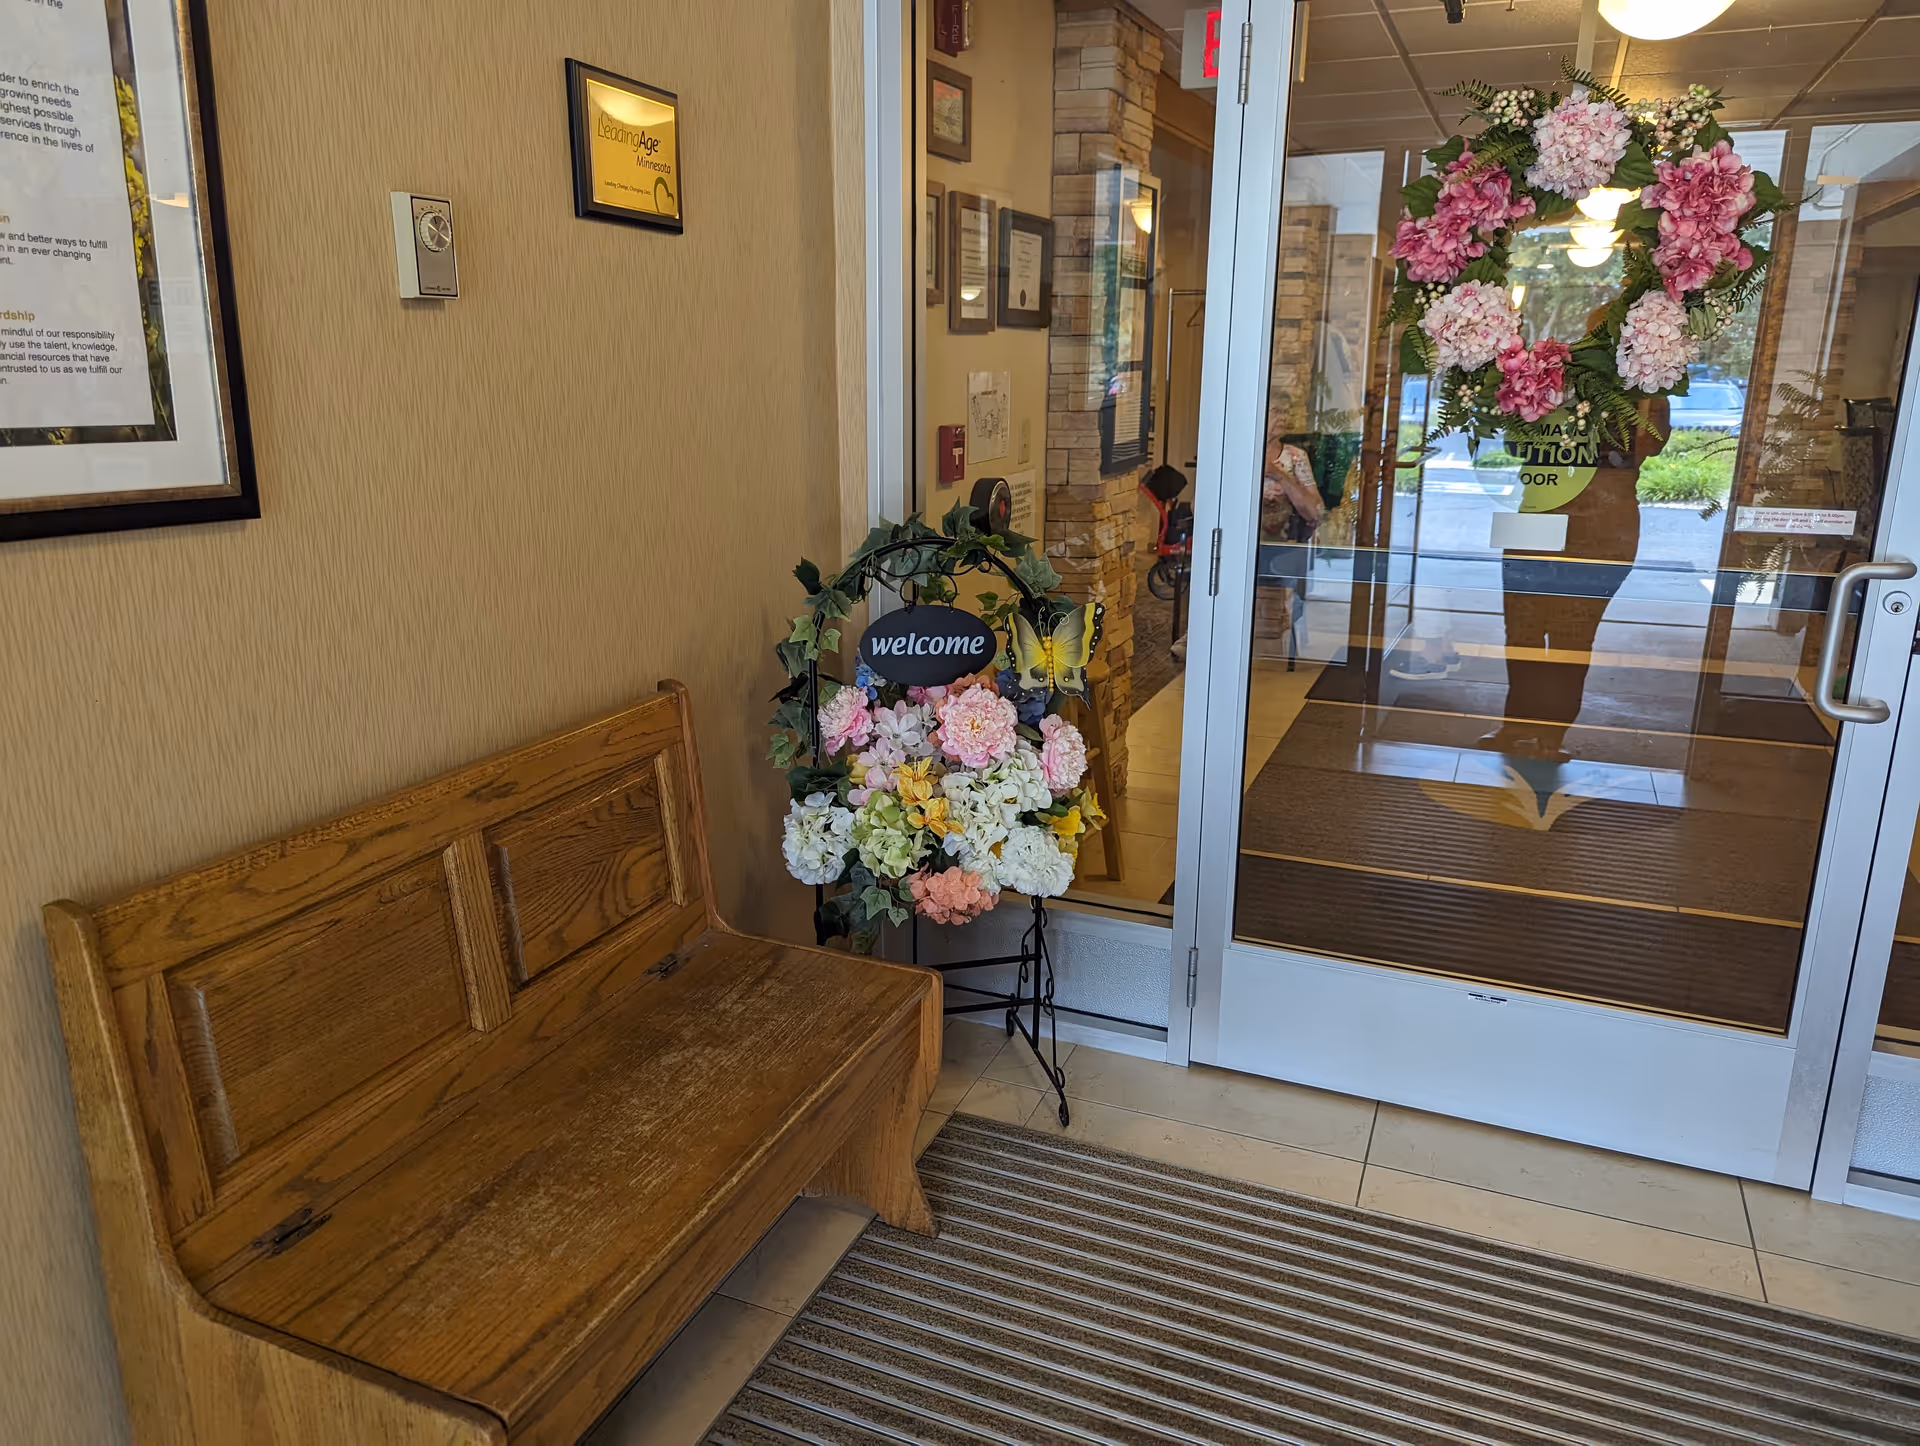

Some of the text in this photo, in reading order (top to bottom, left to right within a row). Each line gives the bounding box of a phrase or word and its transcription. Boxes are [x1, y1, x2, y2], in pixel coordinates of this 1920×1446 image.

[951, 4, 961, 44] FIRE
[18, 76, 29, 86] to
[31, 80, 62, 92] enrich
[64, 84, 80, 96] the
[0, 88, 72, 108] growing needs
[33, 108, 74, 122] possible
[0, 116, 81, 139] services through
[598, 112, 660, 156] LeadingAge
[0, 131, 94, 153] rence in the lives of
[636, 155, 671, 174] Minnesota
[8, 232, 26, 242] and
[27, 233, 53, 244] better
[55, 237, 77, 248] ways
[79, 238, 88, 248] to
[89, 239, 108, 249] fulfill
[7, 244, 16, 253] in
[18, 246, 29, 255] an
[31, 247, 51, 256] ever
[53, 249, 92, 262] changing
[1, 327, 115, 341] mindful of our responsibility
[9, 341, 26, 349] use
[27, 340, 42, 349] the
[43, 340, 71, 351] talent,
[72, 341, 118, 353] knowledge,
[28, 353, 71, 362] resources
[72, 353, 89, 362] that
[90, 353, 111, 363] have
[40, 364, 49, 374] to
[50, 366, 61, 374] us
[63, 366, 74, 374] as
[75, 366, 88, 374] we
[89, 365, 108, 374] fulfill
[109, 367, 123, 375] our
[1521, 472, 1558, 486] OOR
[872, 632, 985, 656] welcome
